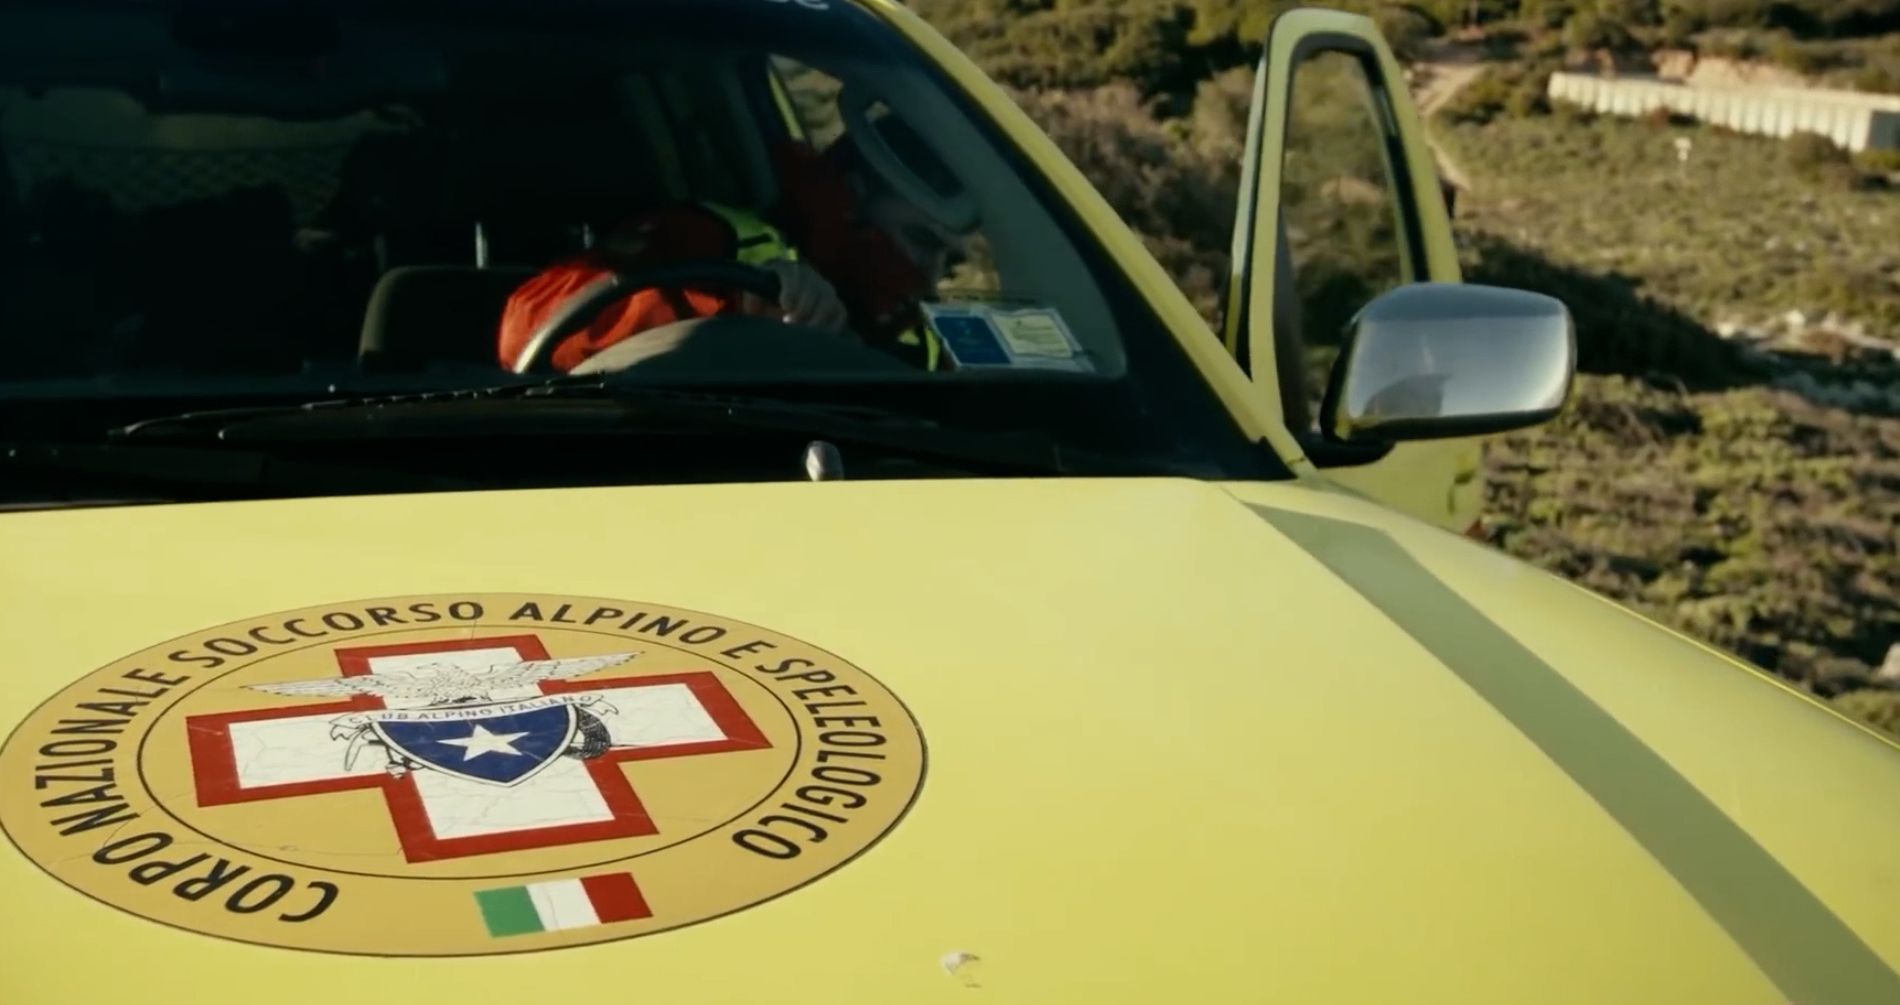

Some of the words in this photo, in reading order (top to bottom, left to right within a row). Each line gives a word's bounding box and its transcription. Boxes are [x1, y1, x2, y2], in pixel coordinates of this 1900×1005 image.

[169, 601, 484, 668] SOCCORSO
[508, 602, 727, 645] ALPINO
[720, 639, 776, 660] E
[349, 712, 409, 724] CLUB
[418, 707, 493, 720] ALPINO
[499, 695, 593, 713] ITALIANO
[35, 668, 191, 836] NAZIONALE
[732, 658, 887, 860] SPELEOLOGICO
[92, 831, 339, 923] CORPO
